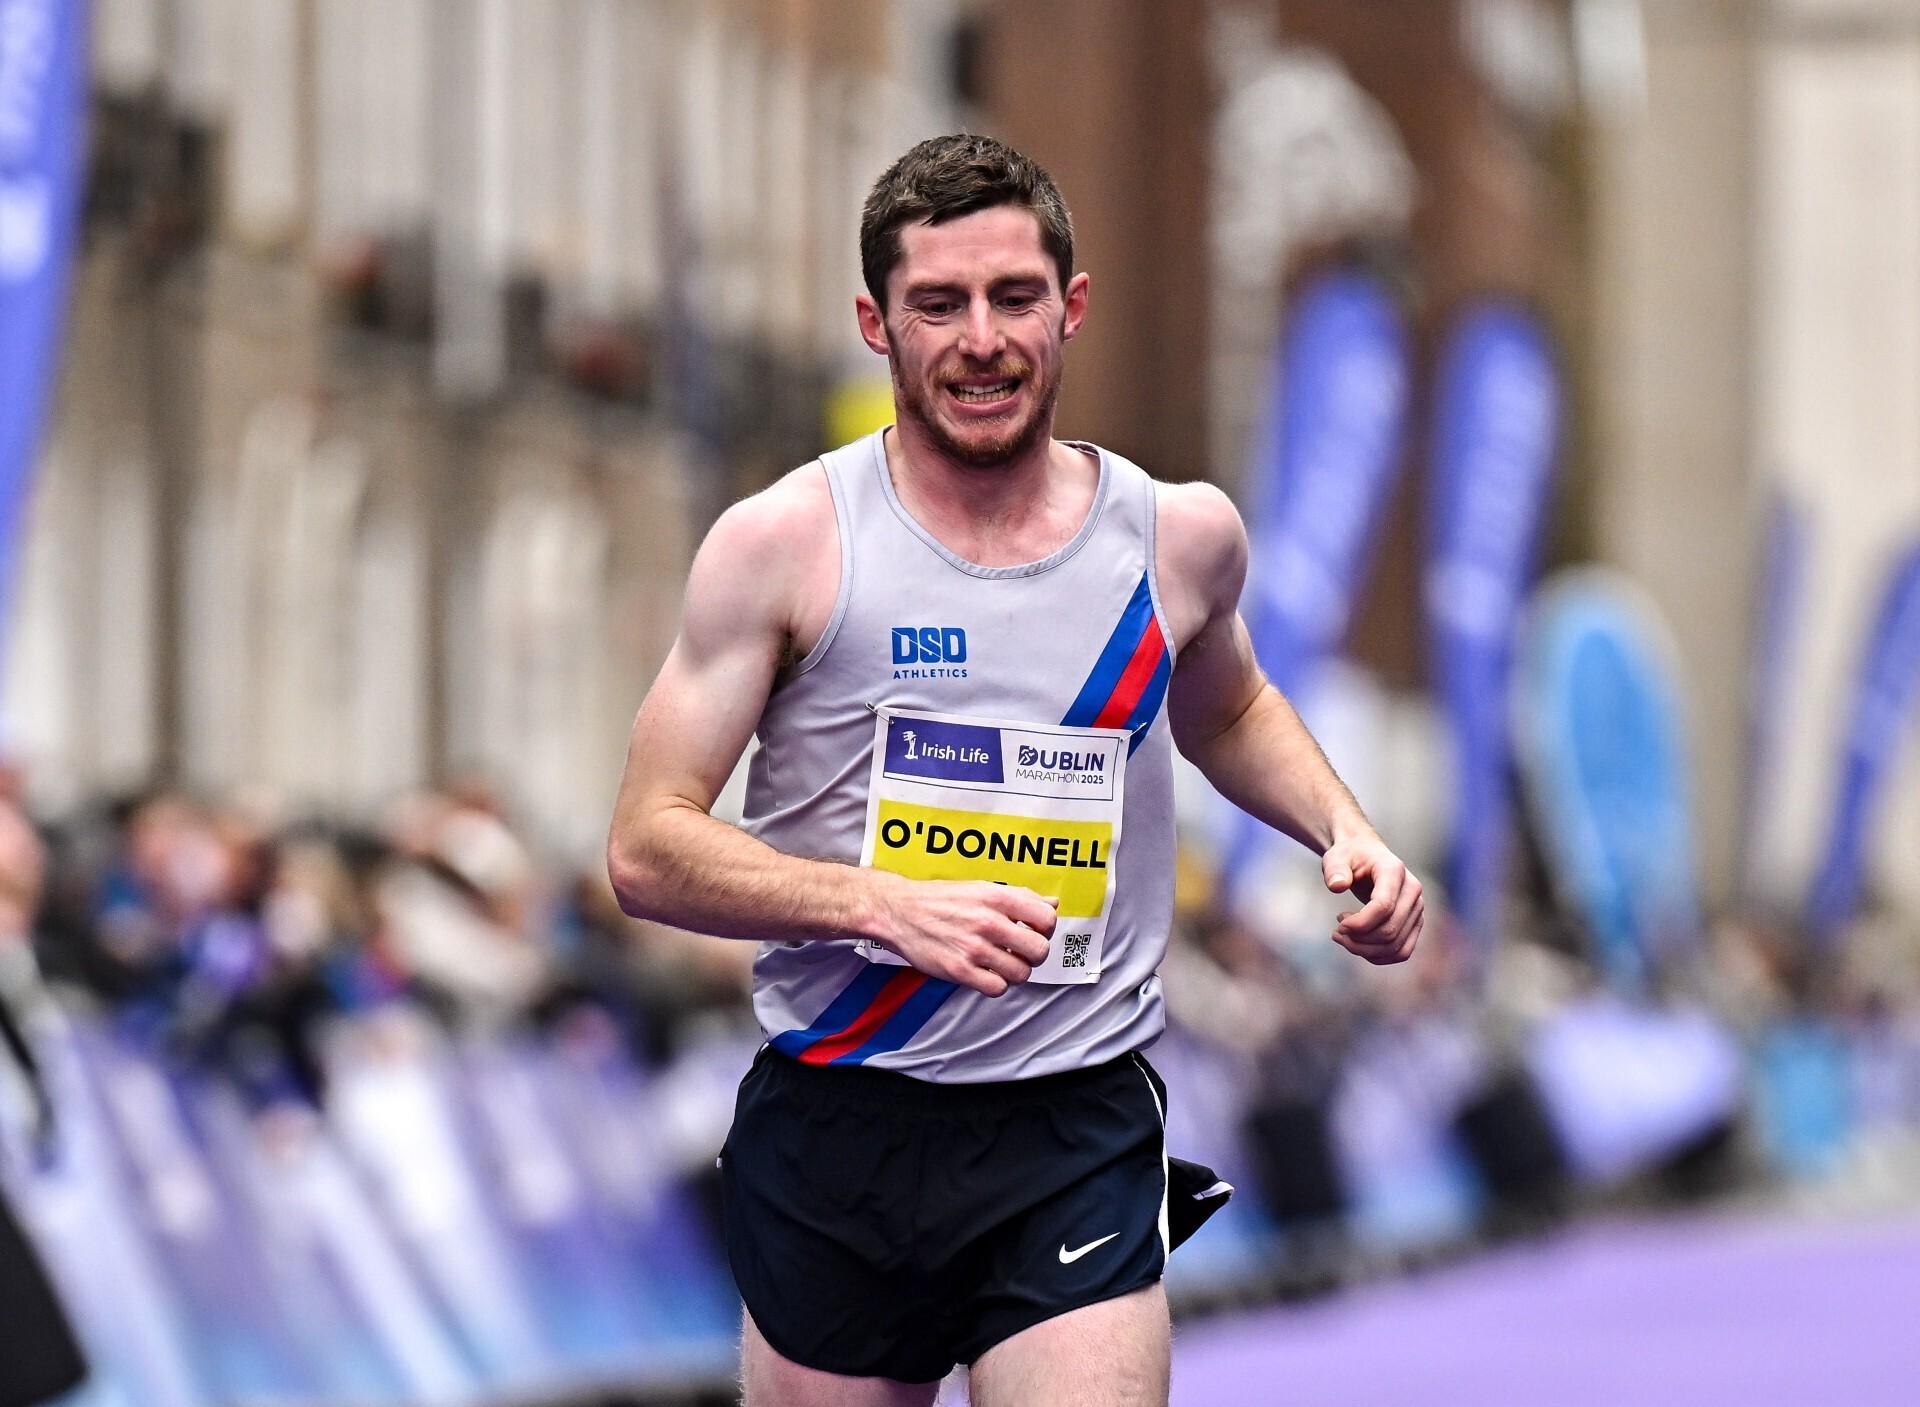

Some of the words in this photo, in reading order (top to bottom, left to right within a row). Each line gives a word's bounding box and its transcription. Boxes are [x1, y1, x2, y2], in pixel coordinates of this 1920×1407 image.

[892, 627, 967, 664] DSD
[893, 669, 968, 680] ATHLETICS
[922, 742, 956, 761] Irish
[960, 747, 989, 764] Life
[1016, 769, 1080, 784] MARATHON
[1081, 773, 1104, 785] 2025
[881, 819, 1106, 868] O'DONNELL
